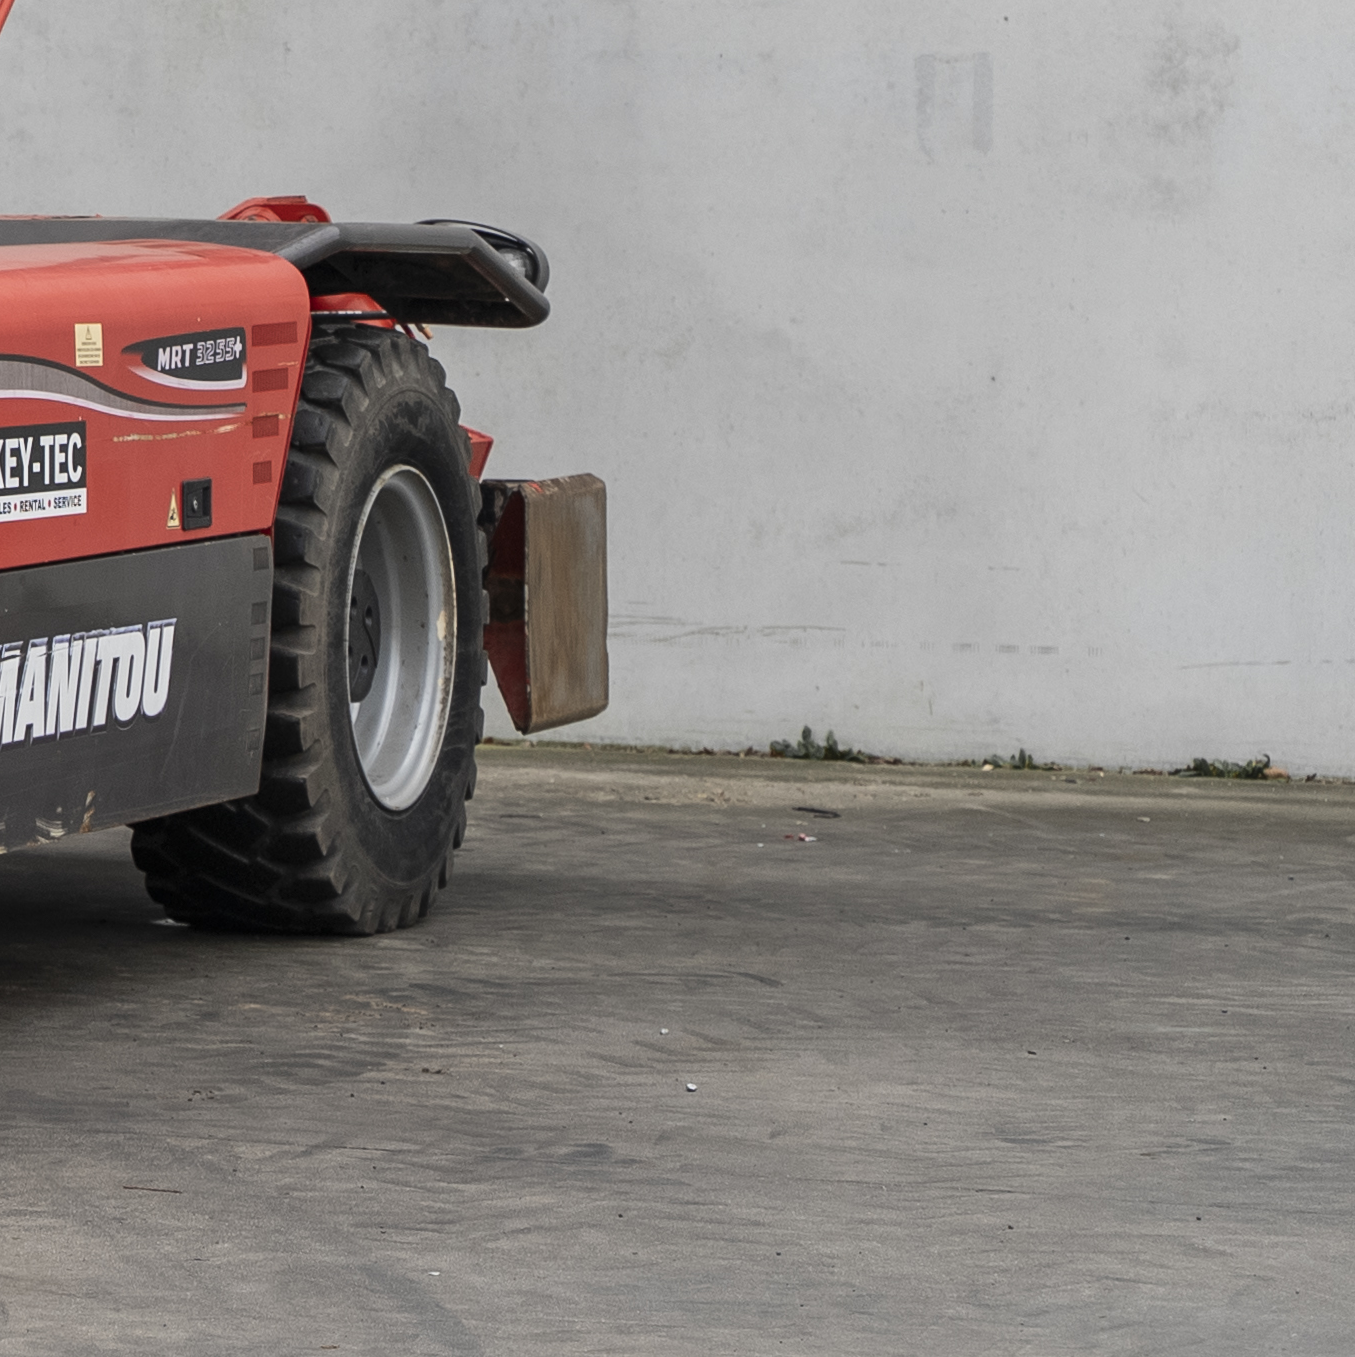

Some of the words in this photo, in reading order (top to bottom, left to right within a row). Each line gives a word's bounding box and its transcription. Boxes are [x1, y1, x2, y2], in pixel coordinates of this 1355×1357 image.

[157, 343, 194, 371] MRT
[19, 497, 46, 513] RENTAL
[53, 494, 82, 509] SERVICE
